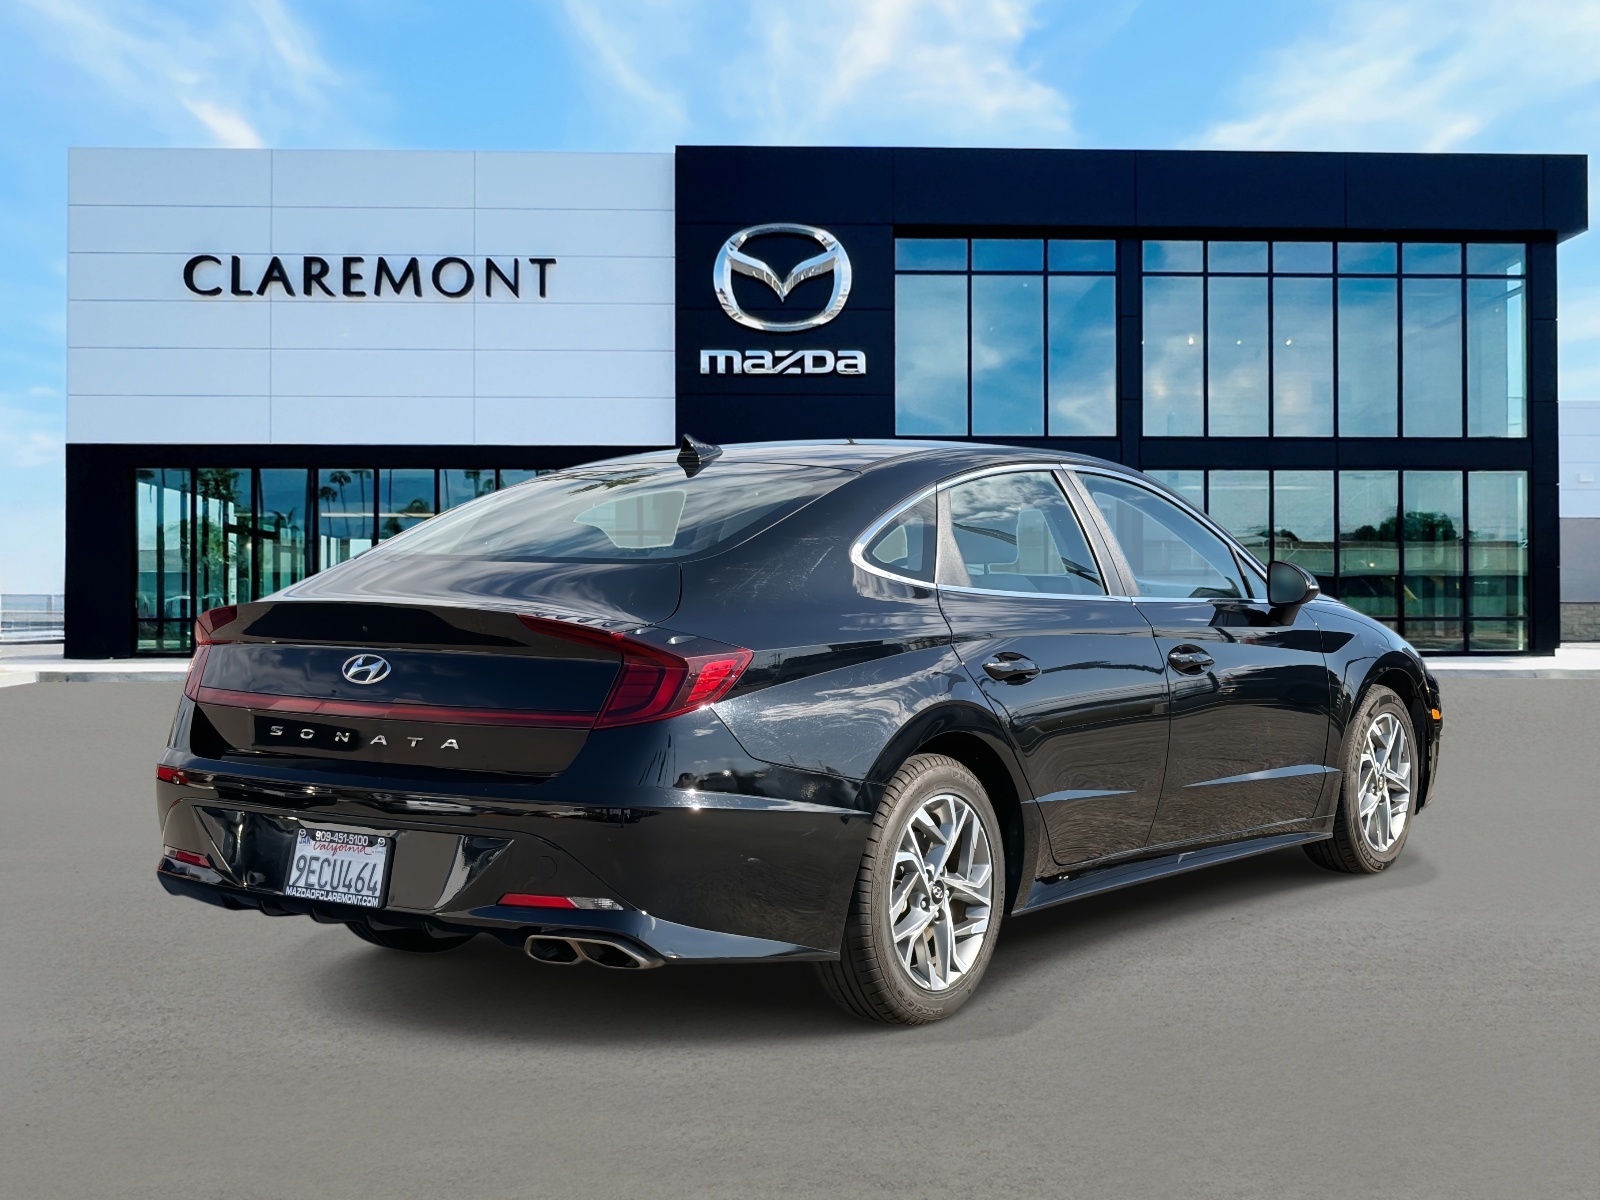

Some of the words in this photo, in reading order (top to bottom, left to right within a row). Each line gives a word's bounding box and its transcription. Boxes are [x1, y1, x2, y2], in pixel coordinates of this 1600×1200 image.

[183, 255, 557, 299] CLAREMONT
[700, 350, 867, 375] mazda
[269, 725, 460, 750] SONATA
[313, 840, 373, 857] California
[315, 830, 369, 846] 909-451-5100
[292, 853, 378, 895] 9ECU464
[285, 885, 379, 908] MAZDAOFCLAREMONT.COM
